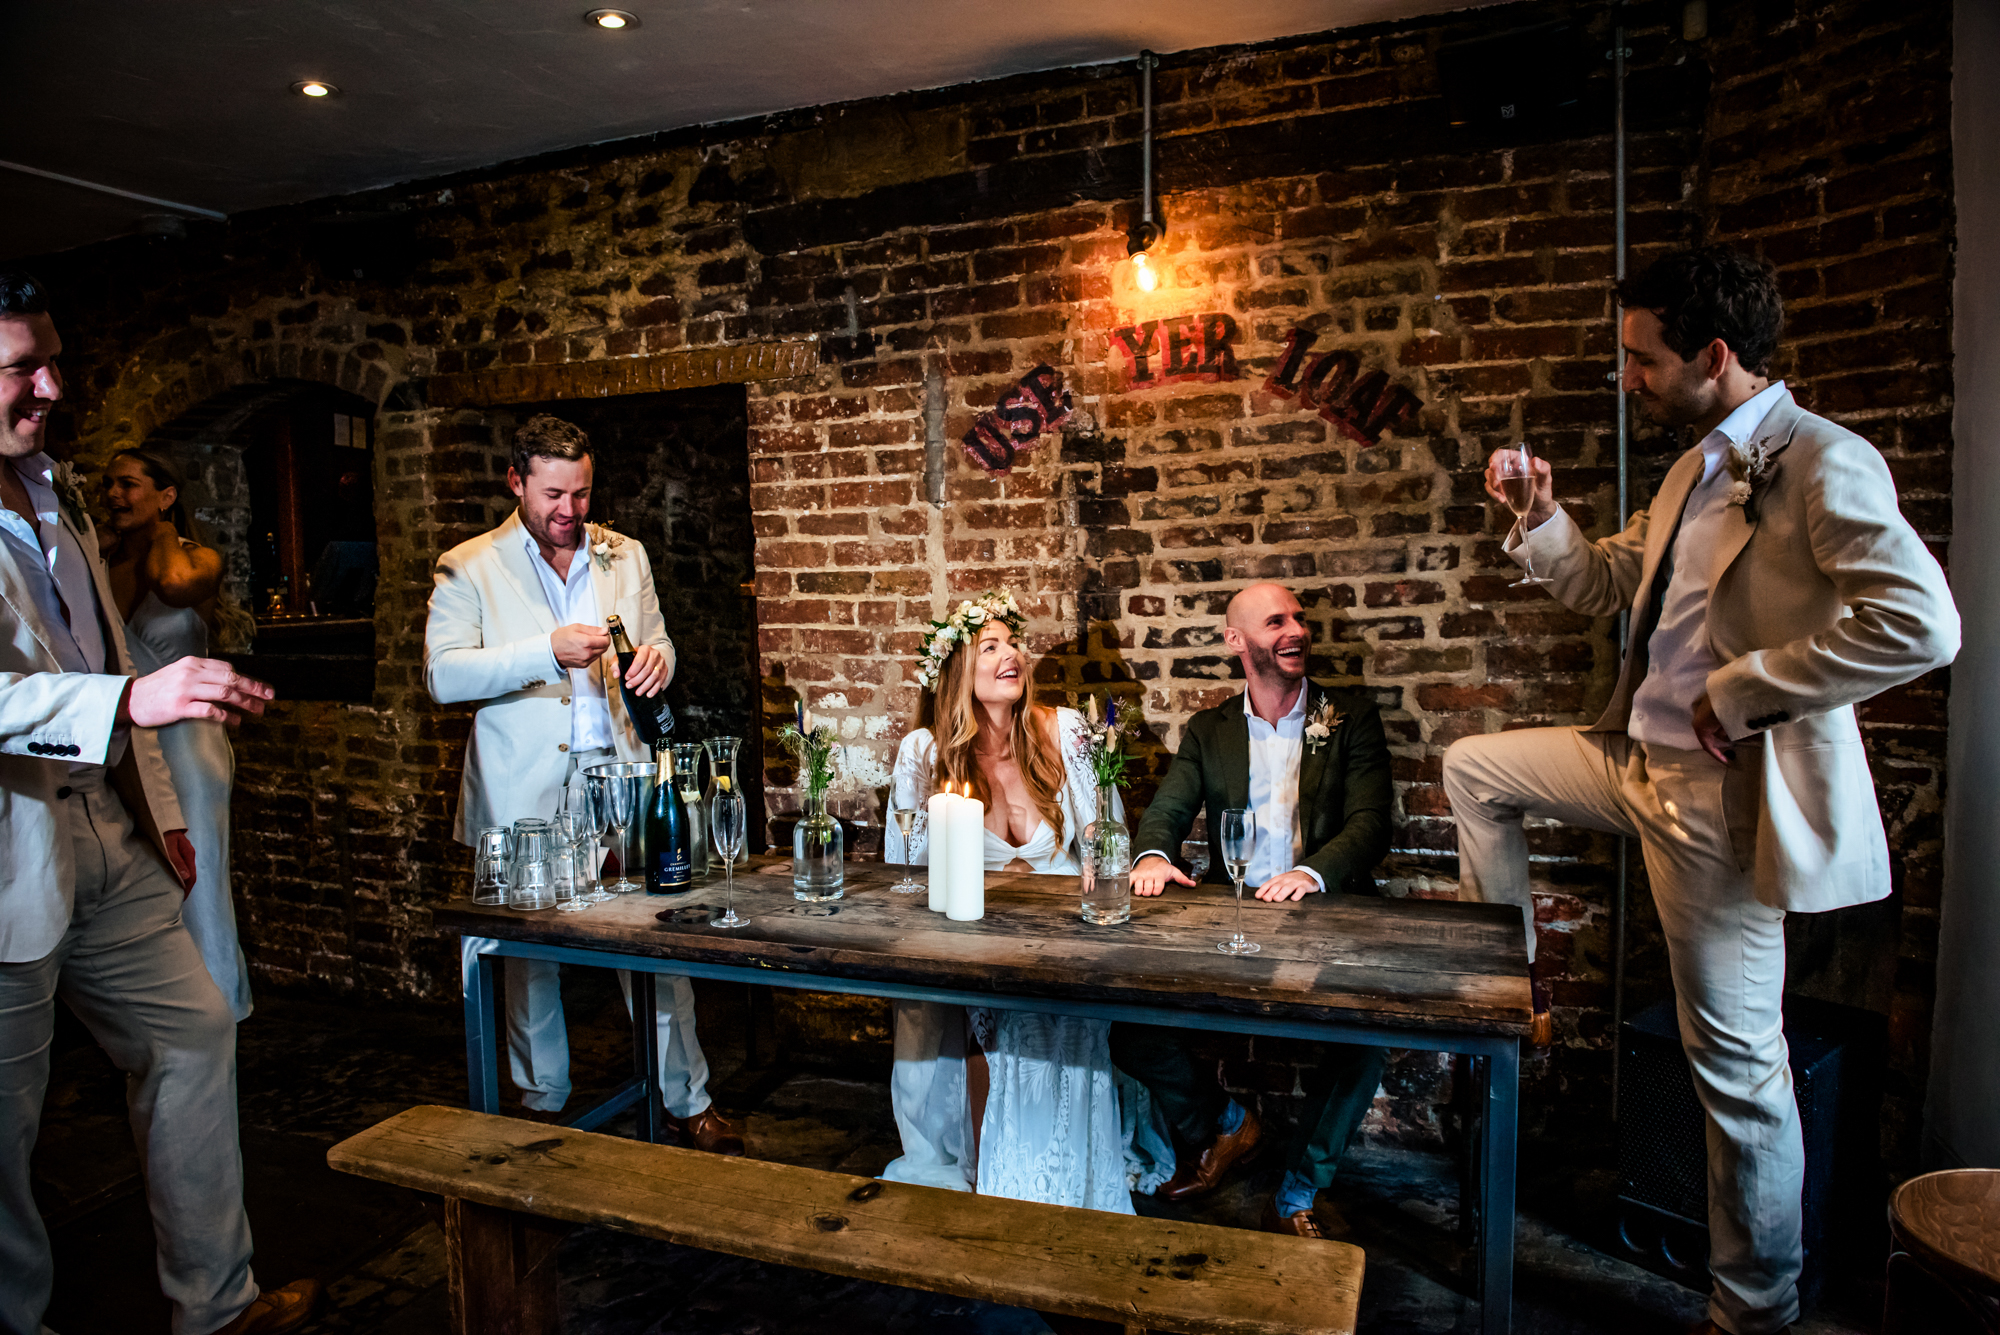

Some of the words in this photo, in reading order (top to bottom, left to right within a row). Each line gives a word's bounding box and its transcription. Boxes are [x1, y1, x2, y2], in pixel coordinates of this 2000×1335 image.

[961, 362, 1073, 477] USE
[1109, 312, 1241, 390] YER
[1262, 327, 1425, 447] LOAF
